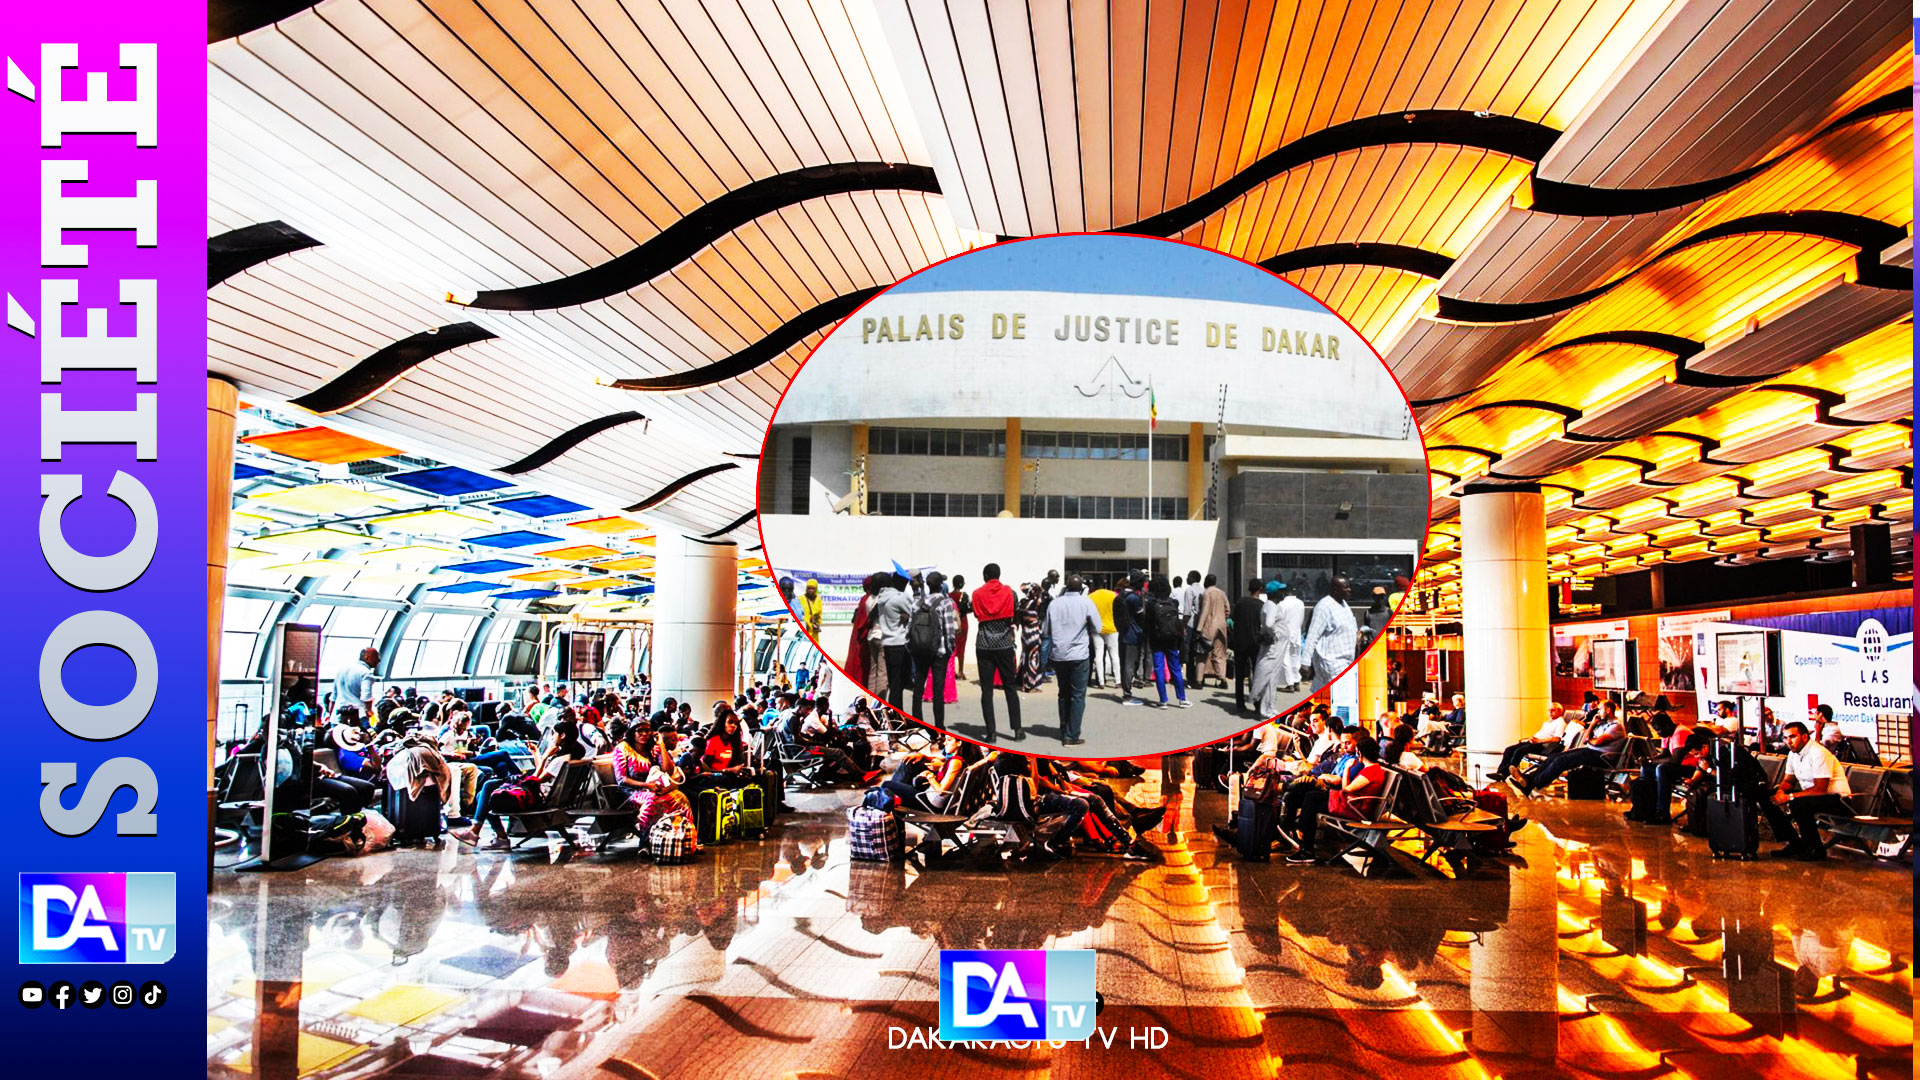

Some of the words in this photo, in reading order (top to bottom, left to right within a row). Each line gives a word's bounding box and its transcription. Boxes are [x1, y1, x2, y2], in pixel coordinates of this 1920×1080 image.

[862, 313, 964, 344] PALAIS
[992, 313, 1026, 340] DE
[1054, 315, 1180, 346] JUSTICE
[1206, 321, 1238, 350] DE
[1262, 326, 1340, 361] DAKAR
[1794, 655, 1823, 668] Opening
